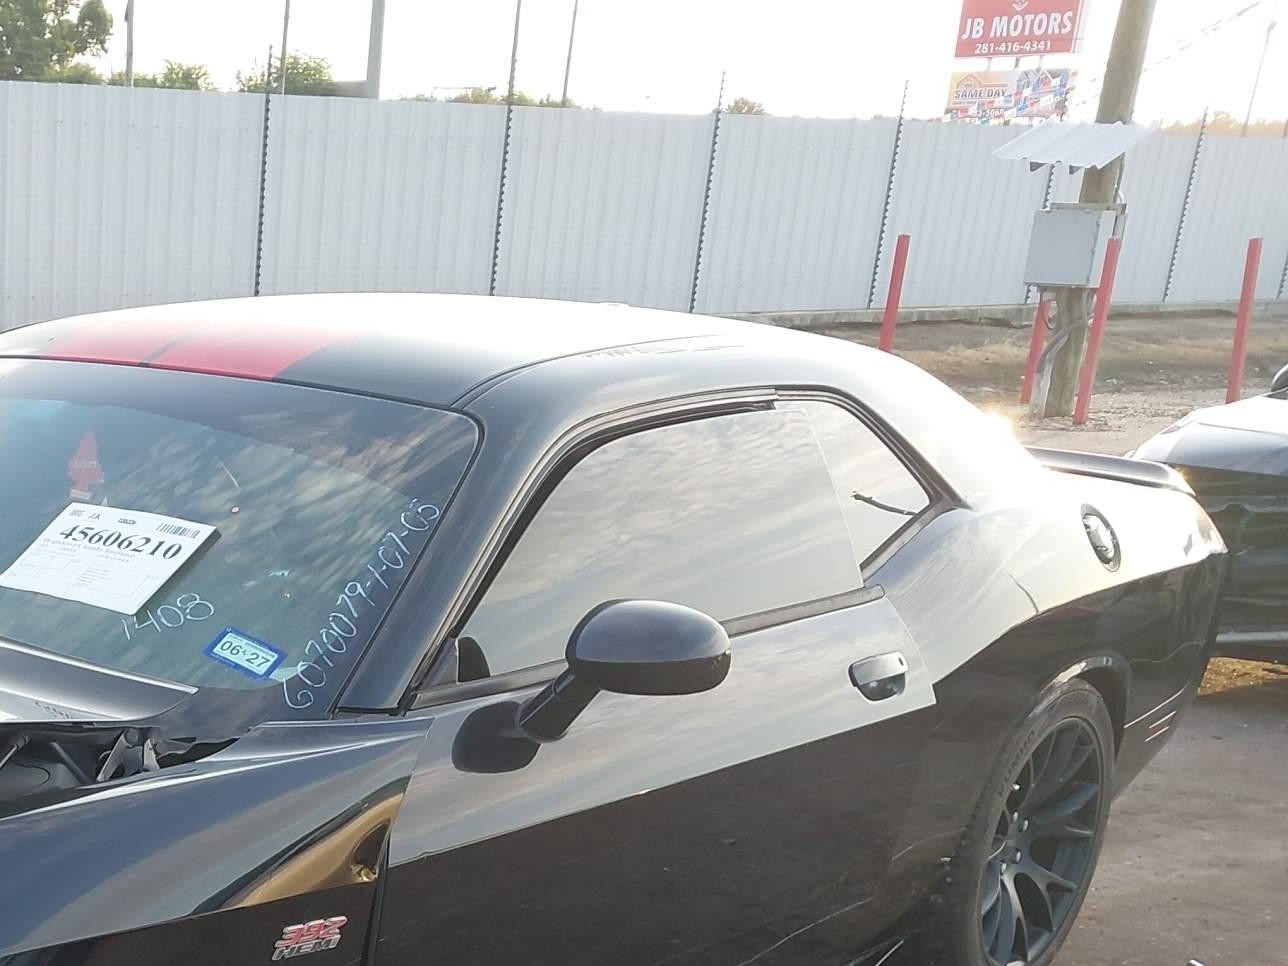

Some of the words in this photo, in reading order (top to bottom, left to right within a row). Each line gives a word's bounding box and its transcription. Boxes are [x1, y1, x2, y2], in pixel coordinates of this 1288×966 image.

[962, 18, 984, 39] JB
[990, 11, 1073, 38] MOTORS
[975, 41, 1051, 54] 281-416-4341
[955, 88, 983, 99] SAME
[987, 88, 1008, 98] DAY
[60, 524, 183, 560] 45606210
[121, 592, 214, 640] 1408
[220, 640, 243, 656] 06
[245, 652, 271, 669] 27
